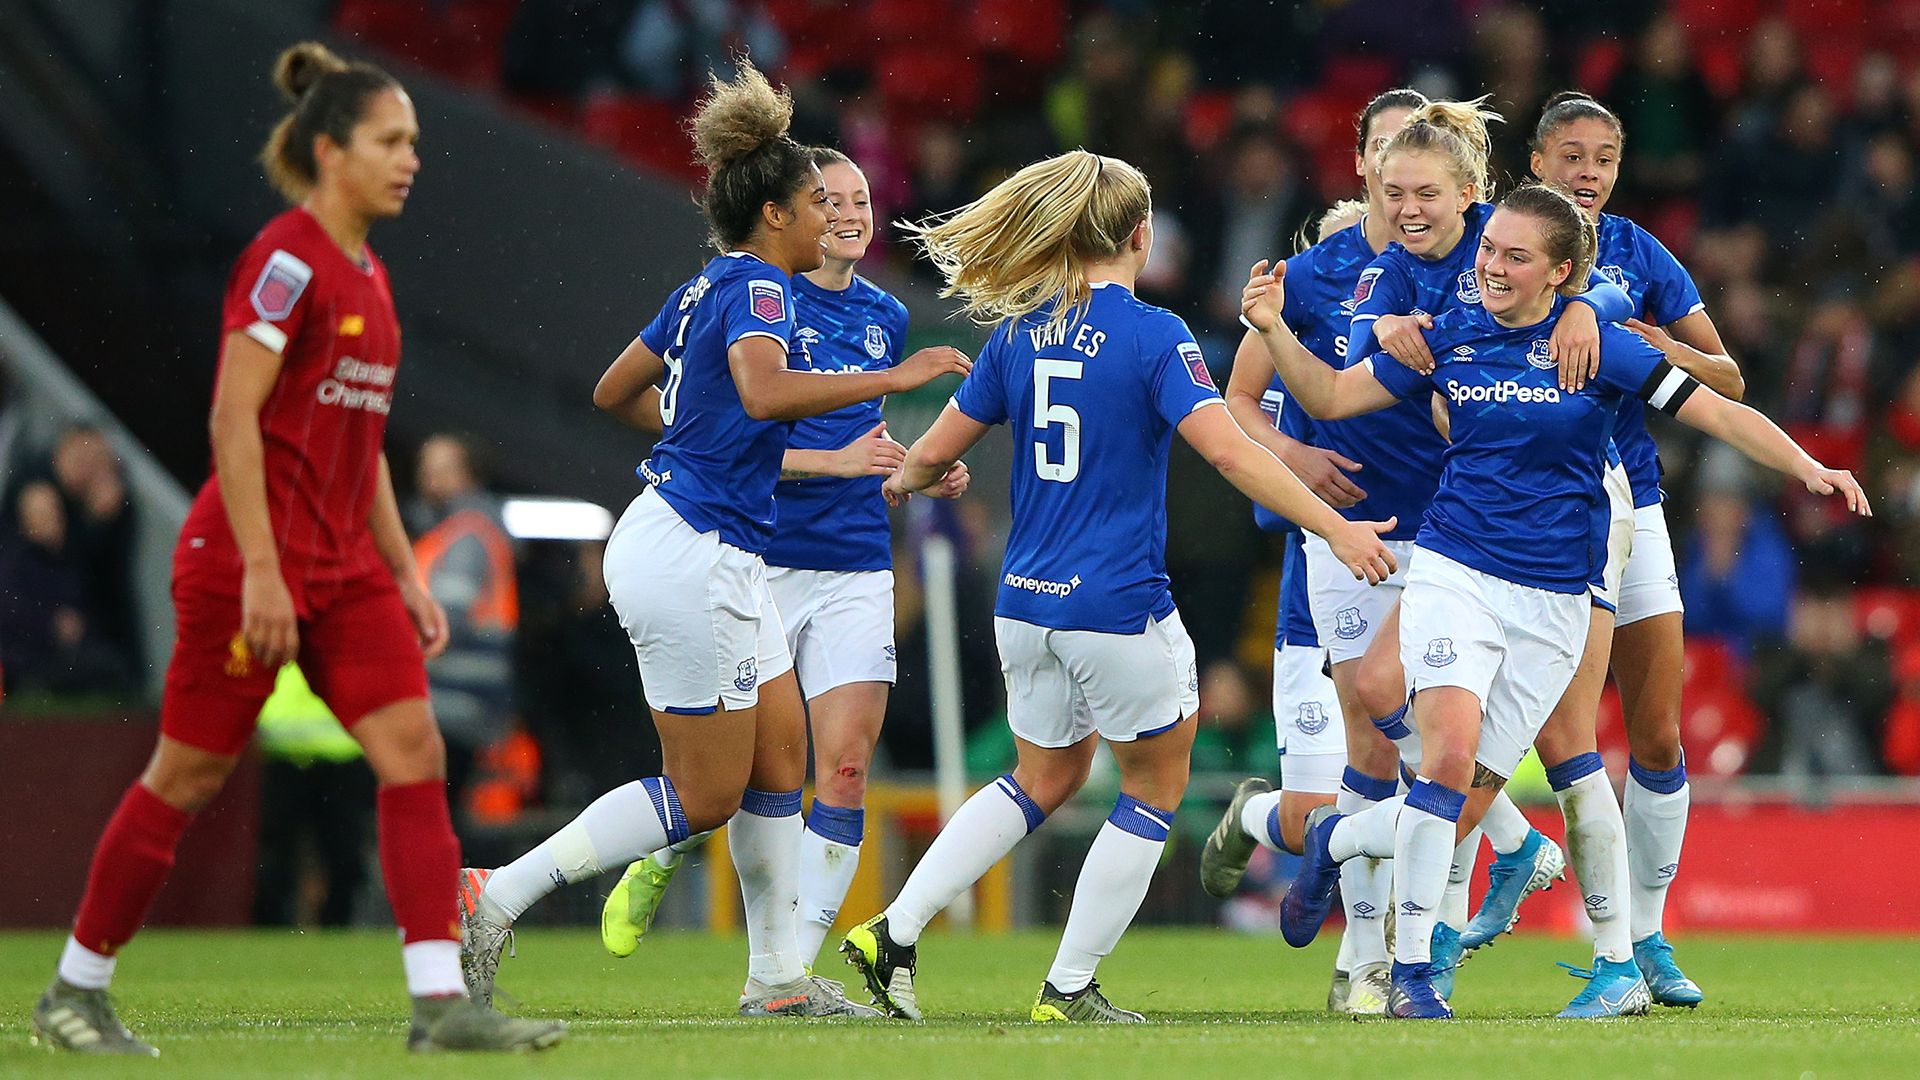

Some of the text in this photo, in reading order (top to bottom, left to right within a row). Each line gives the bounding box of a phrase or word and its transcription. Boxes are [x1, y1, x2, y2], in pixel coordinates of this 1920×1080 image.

[1029, 318, 1106, 358] VAN ES
[1453, 354, 1473, 362] umbro
[1447, 380, 1561, 407] SportPesa
[1034, 359, 1083, 483] 5
[1004, 572, 1071, 598] moneycorp
